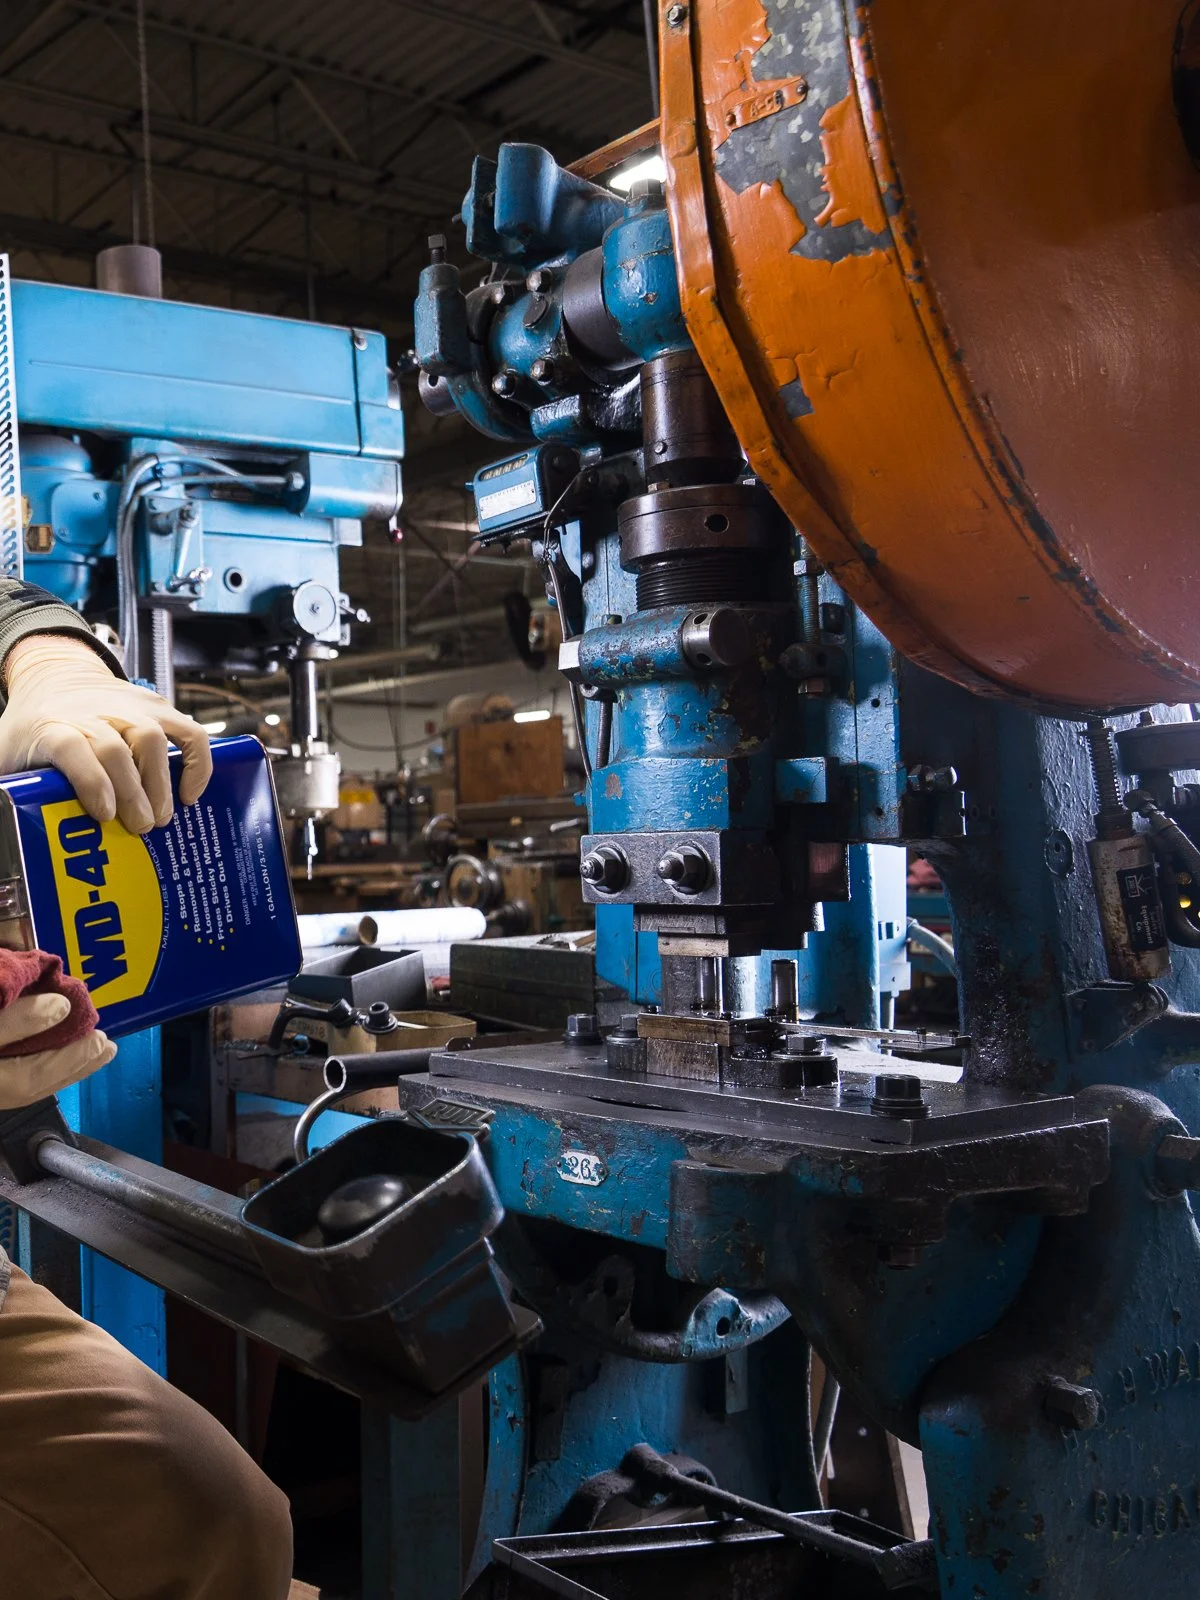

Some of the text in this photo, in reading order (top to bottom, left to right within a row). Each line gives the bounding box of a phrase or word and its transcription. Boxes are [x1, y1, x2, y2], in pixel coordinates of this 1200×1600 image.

[57, 815, 128, 992] WD-40
[141, 831, 170, 948] MULTI-USE PRODUC
[164, 831, 187, 919] Stops Squeaks
[173, 811, 201, 932] Removes & Protects
[184, 806, 212, 933] Loosens Rusted Parts
[194, 800, 224, 940] Frees Sticky Mechanism
[206, 805, 233, 922] Drives Out Moisture
[1092, 1485, 1200, 1538] CHICA
